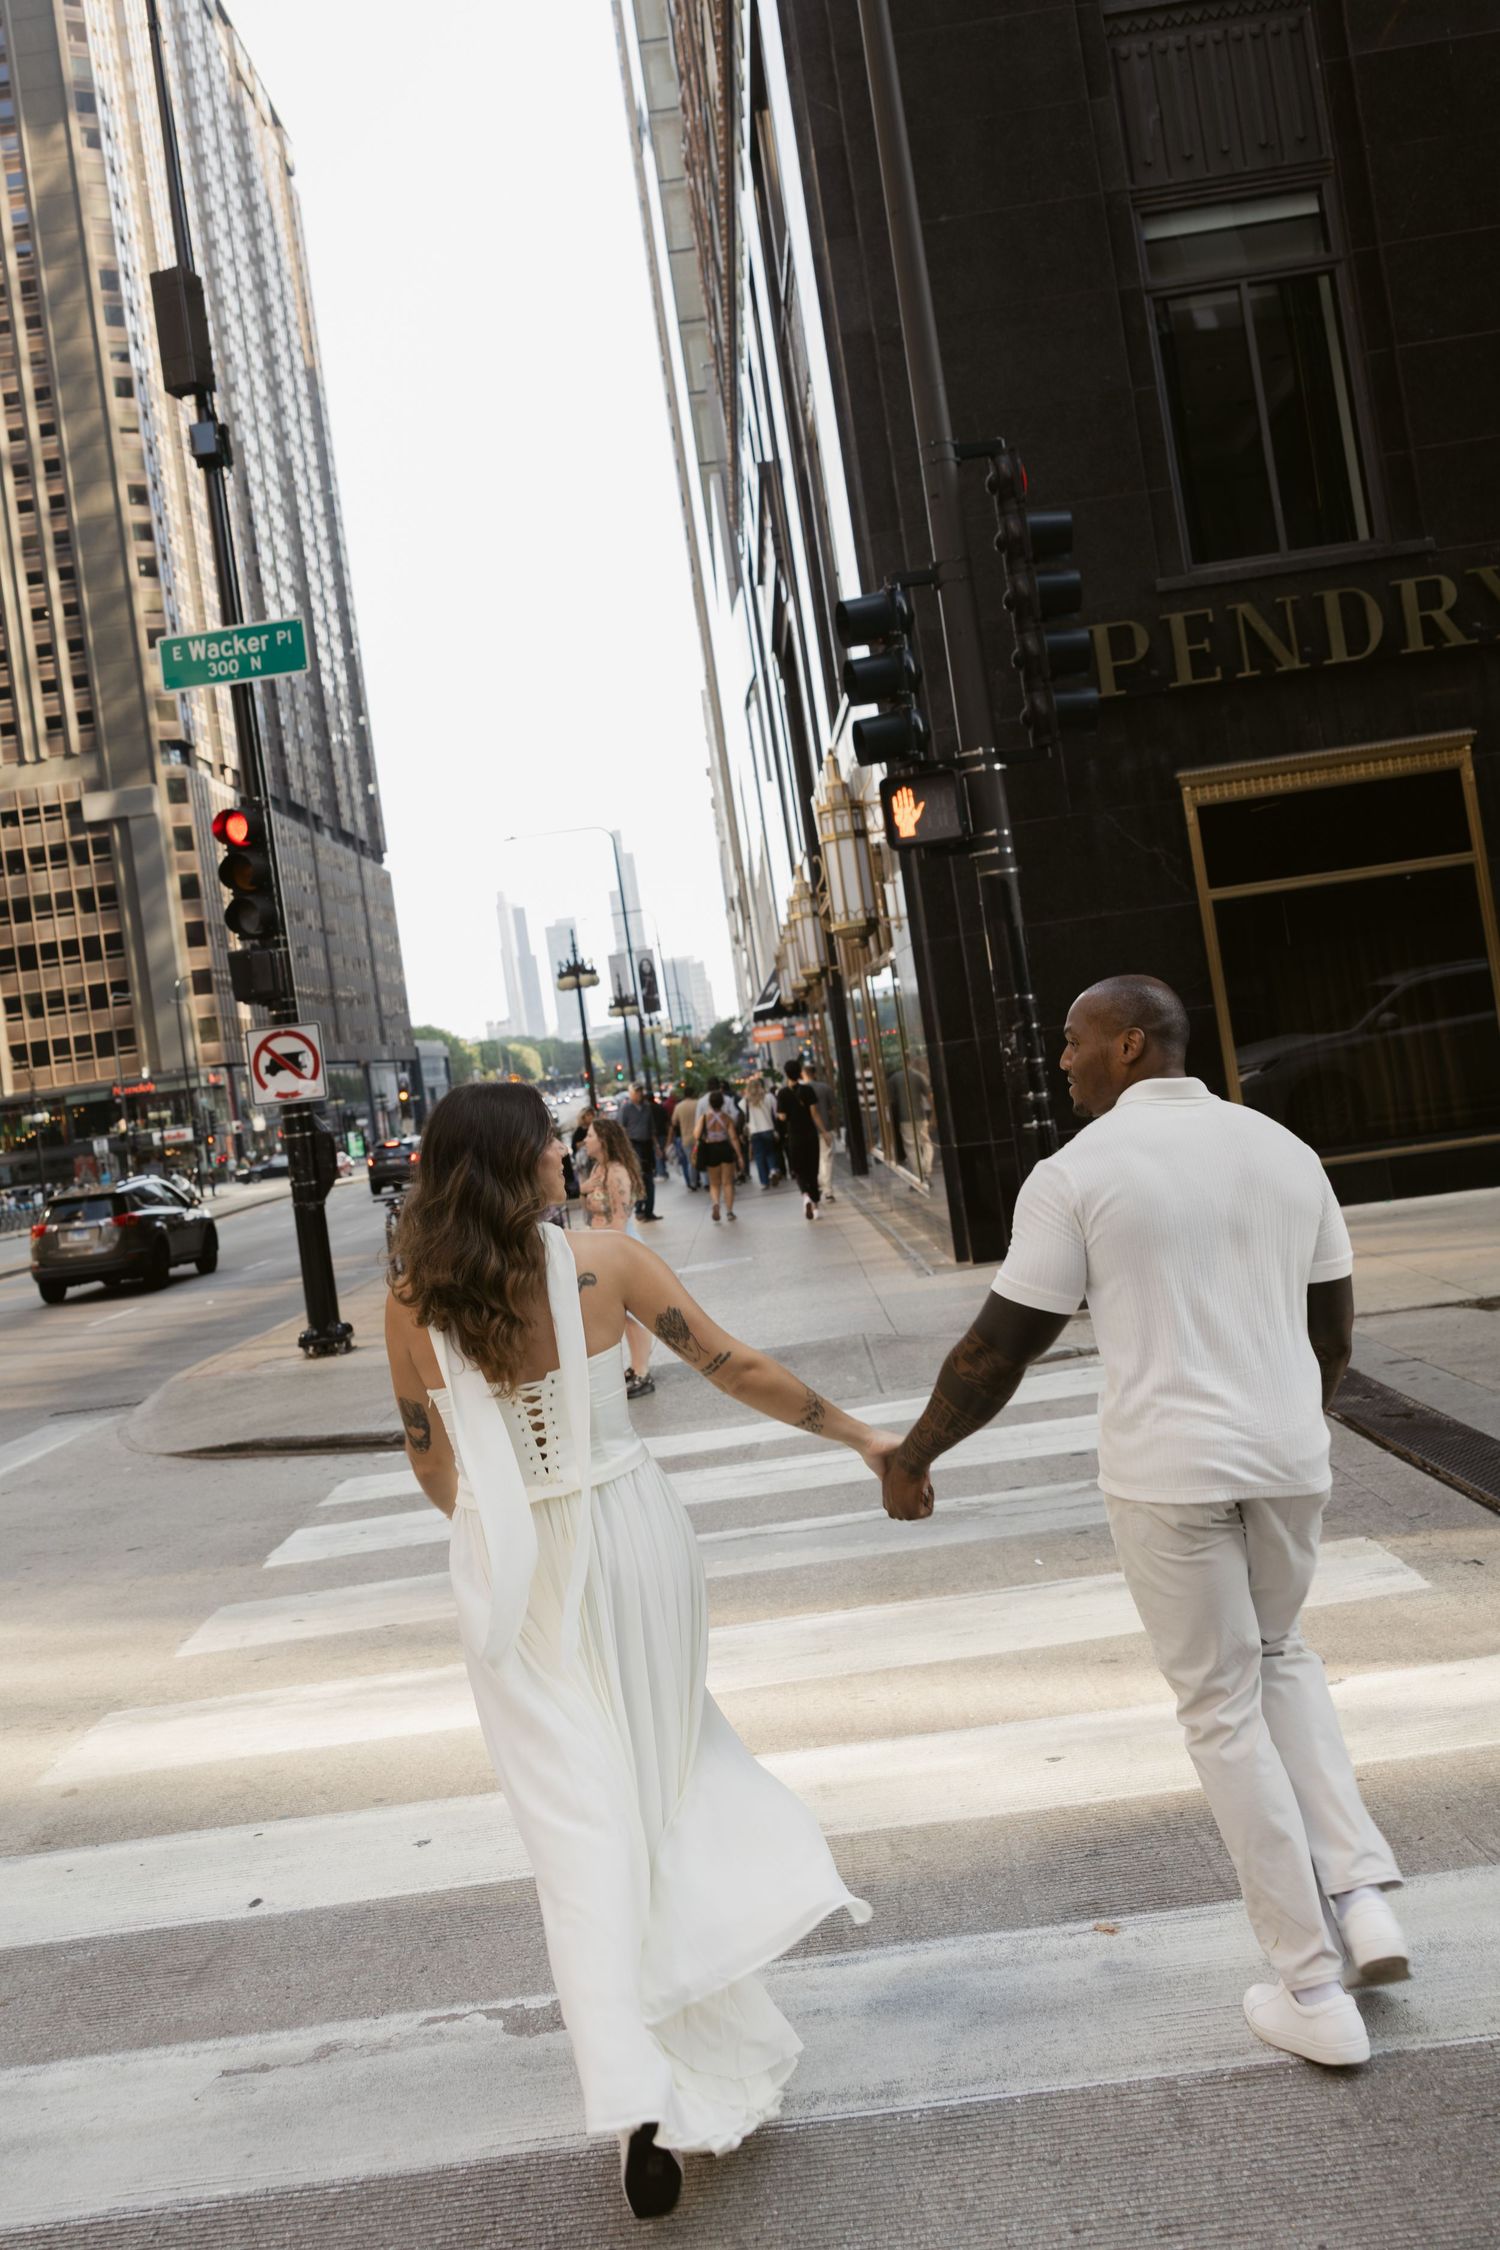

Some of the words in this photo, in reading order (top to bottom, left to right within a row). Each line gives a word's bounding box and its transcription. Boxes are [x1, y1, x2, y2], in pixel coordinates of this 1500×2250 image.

[172, 645, 183, 661] E
[187, 634, 269, 662] Wacker
[276, 629, 292, 646] Pl
[207, 658, 239, 678] 300
[250, 655, 262, 671] N
